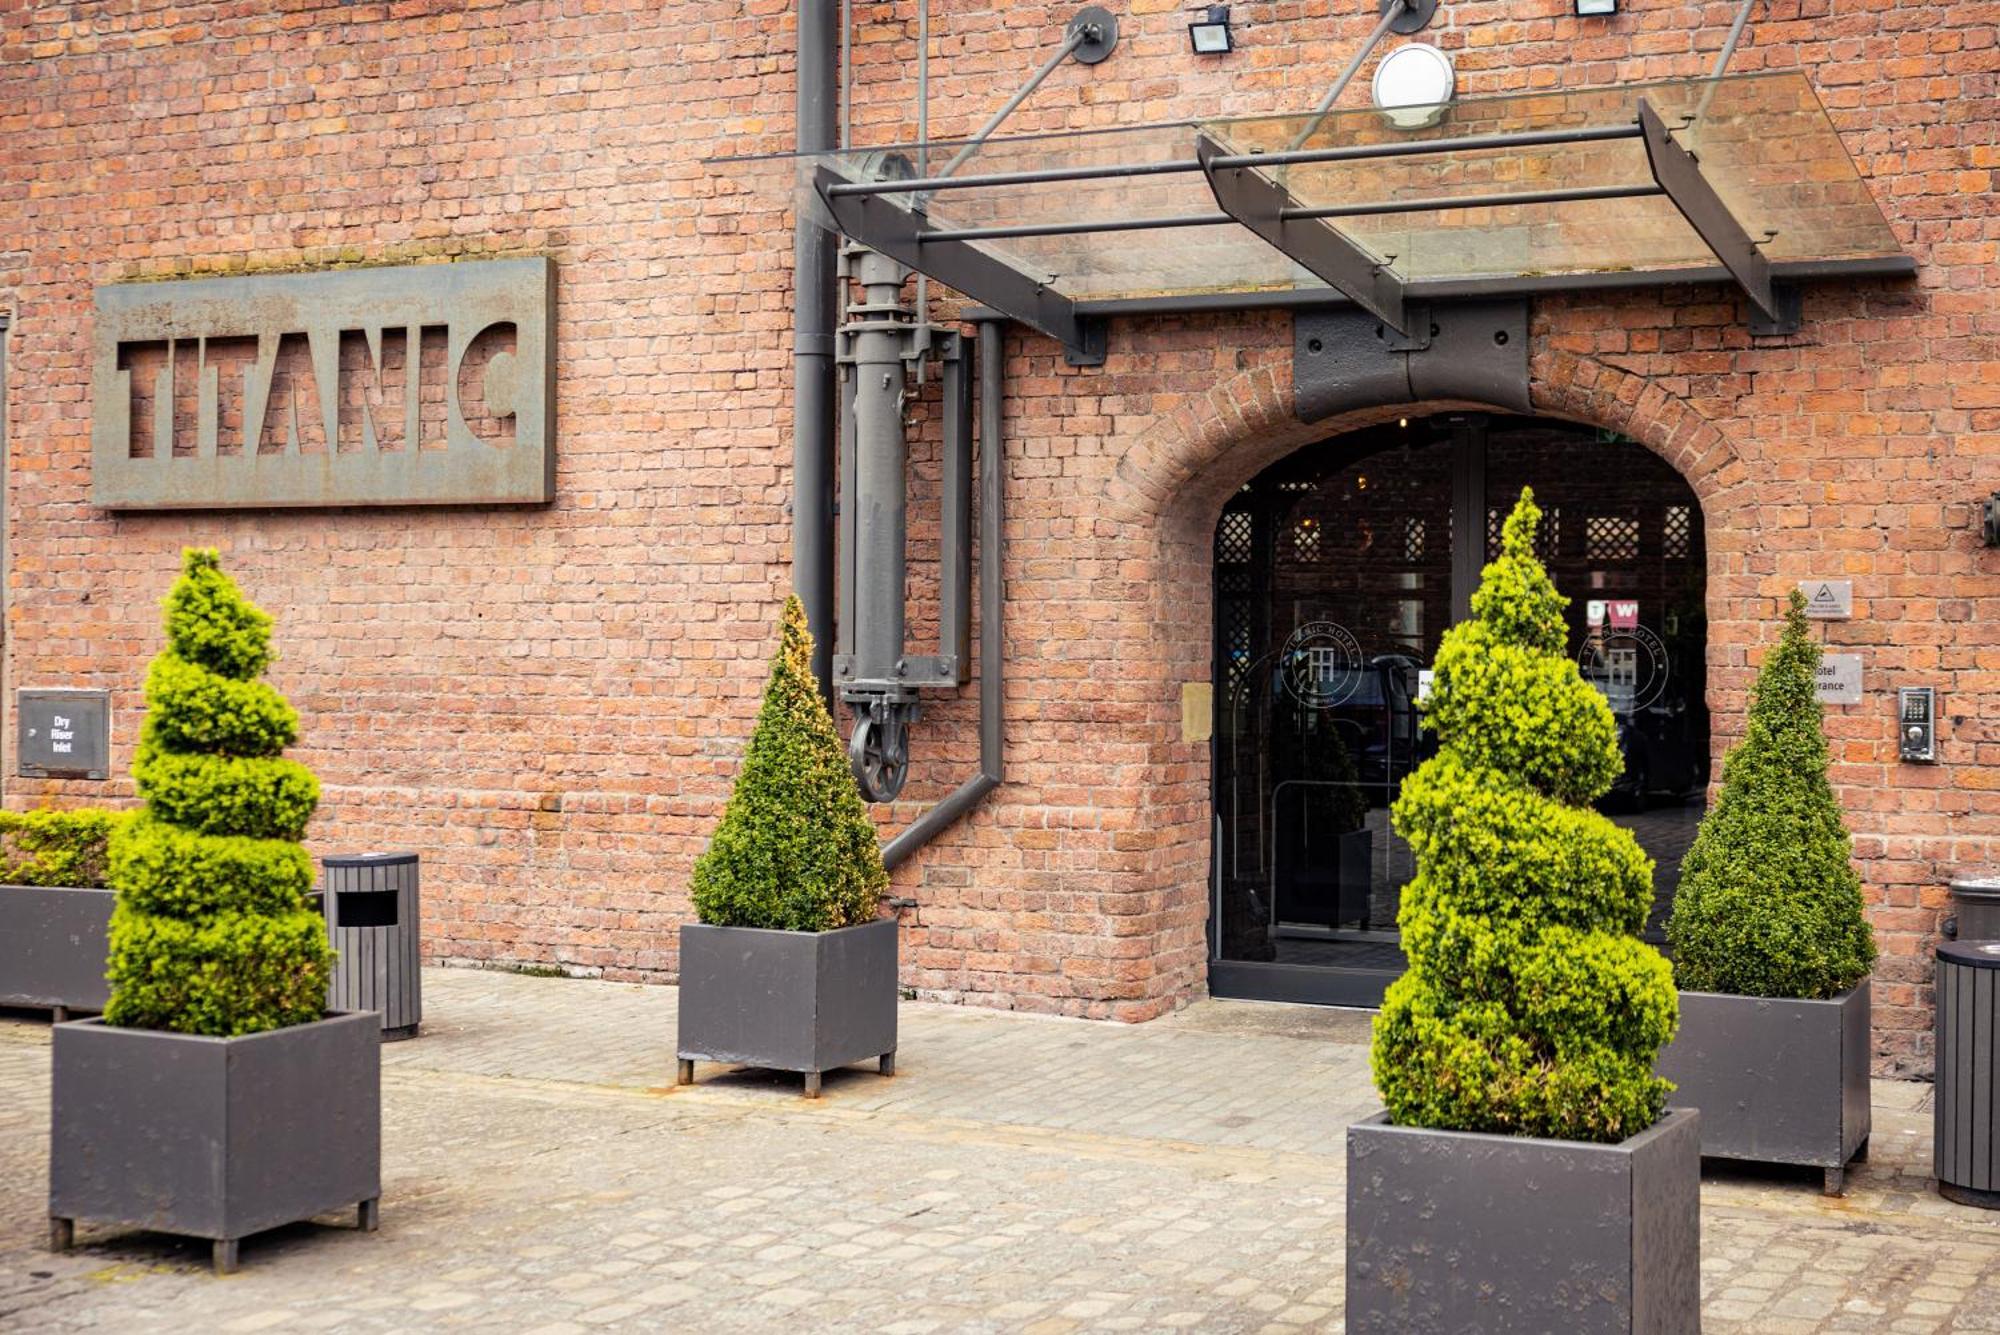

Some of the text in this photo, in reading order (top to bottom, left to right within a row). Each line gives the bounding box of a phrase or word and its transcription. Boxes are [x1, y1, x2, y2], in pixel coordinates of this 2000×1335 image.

[116, 321, 518, 459] TITANIC
[1328, 626, 1356, 655] HOTEL
[1816, 682, 1845, 690] rance
[54, 715, 70, 729] Dry
[51, 728, 74, 740] Riser
[53, 742, 72, 753] Inlet
